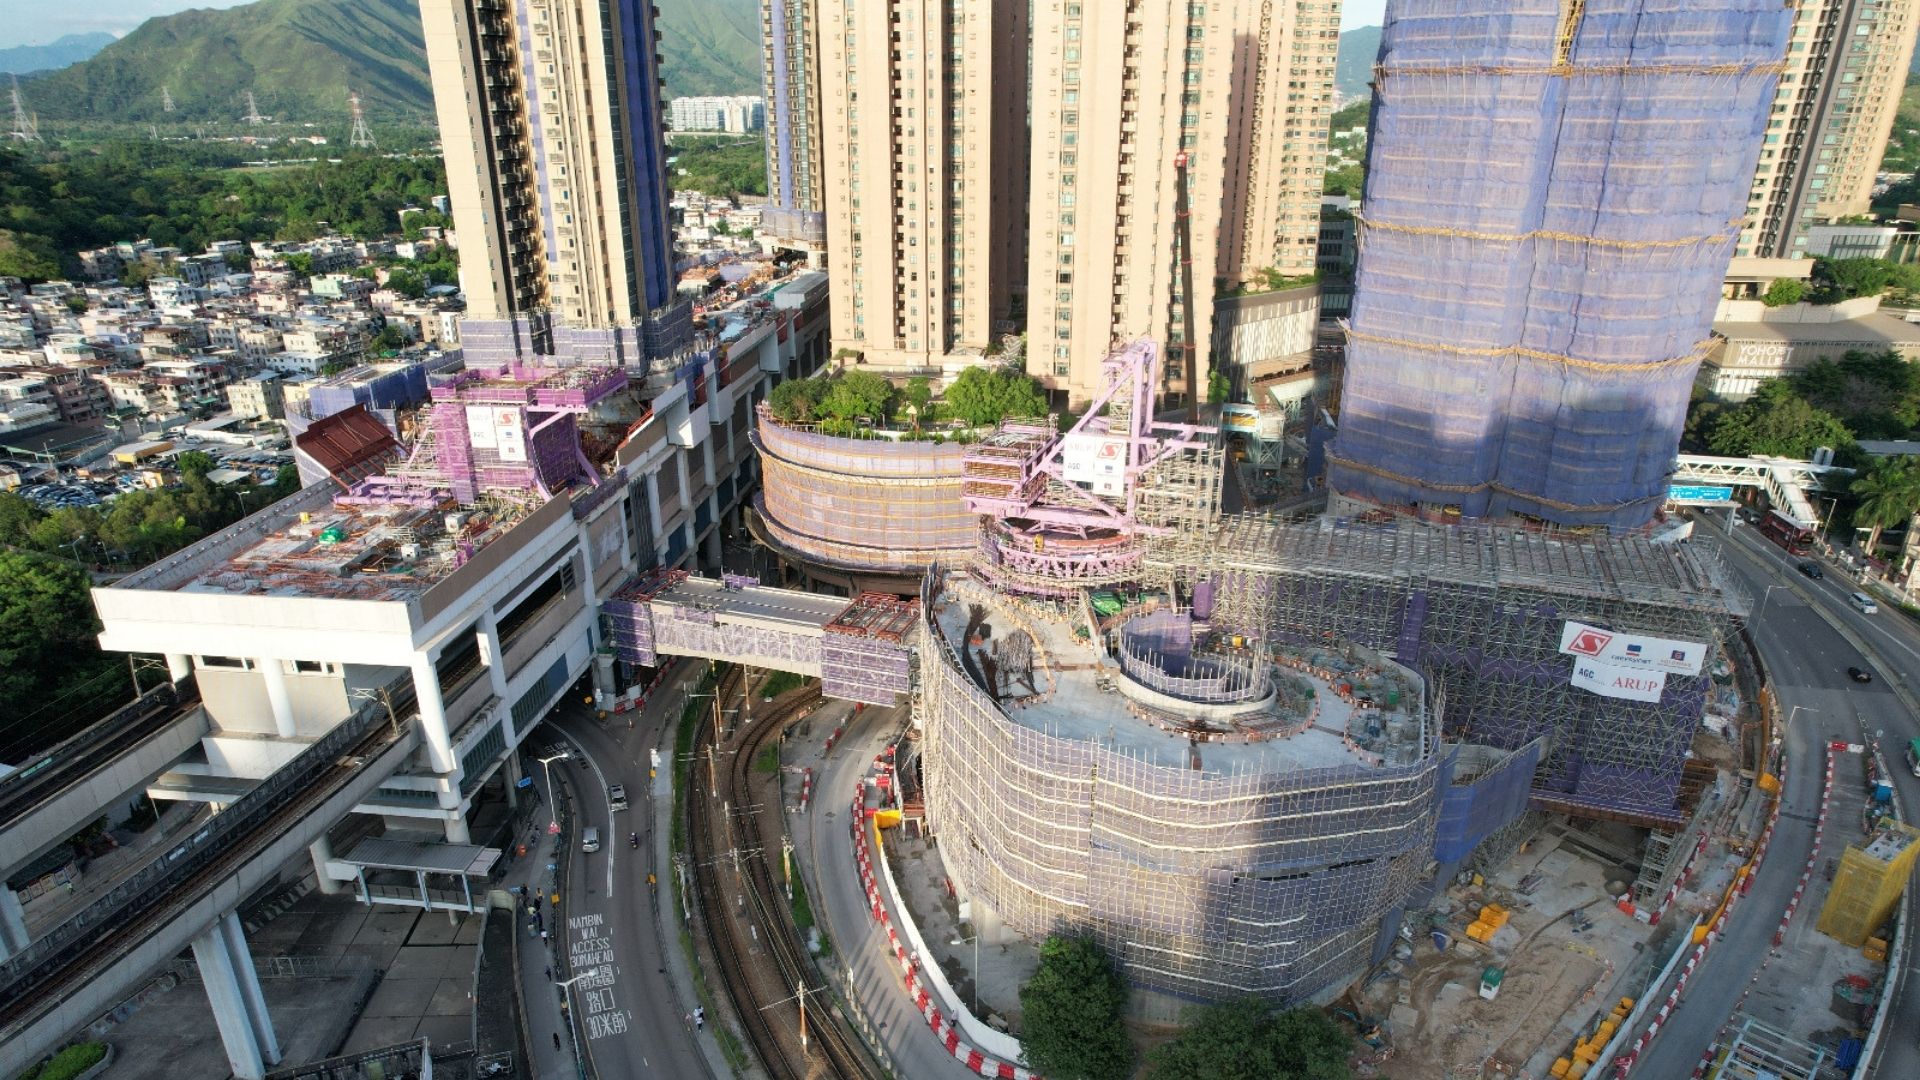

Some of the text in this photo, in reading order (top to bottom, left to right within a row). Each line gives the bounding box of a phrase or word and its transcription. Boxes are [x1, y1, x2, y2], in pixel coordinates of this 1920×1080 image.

[1740, 345, 1777, 356] YOHO
[1736, 355, 1777, 366] MALL
[1578, 667, 1595, 679] AGC
[1611, 675, 1658, 692] ARUP
[544, 741, 568, 753] SLOW
[581, 926, 598, 940] WAI
[571, 937, 611, 955] ACCESS
[586, 987, 616, 1014] 路口
[586, 1010, 628, 1040] 30米前
